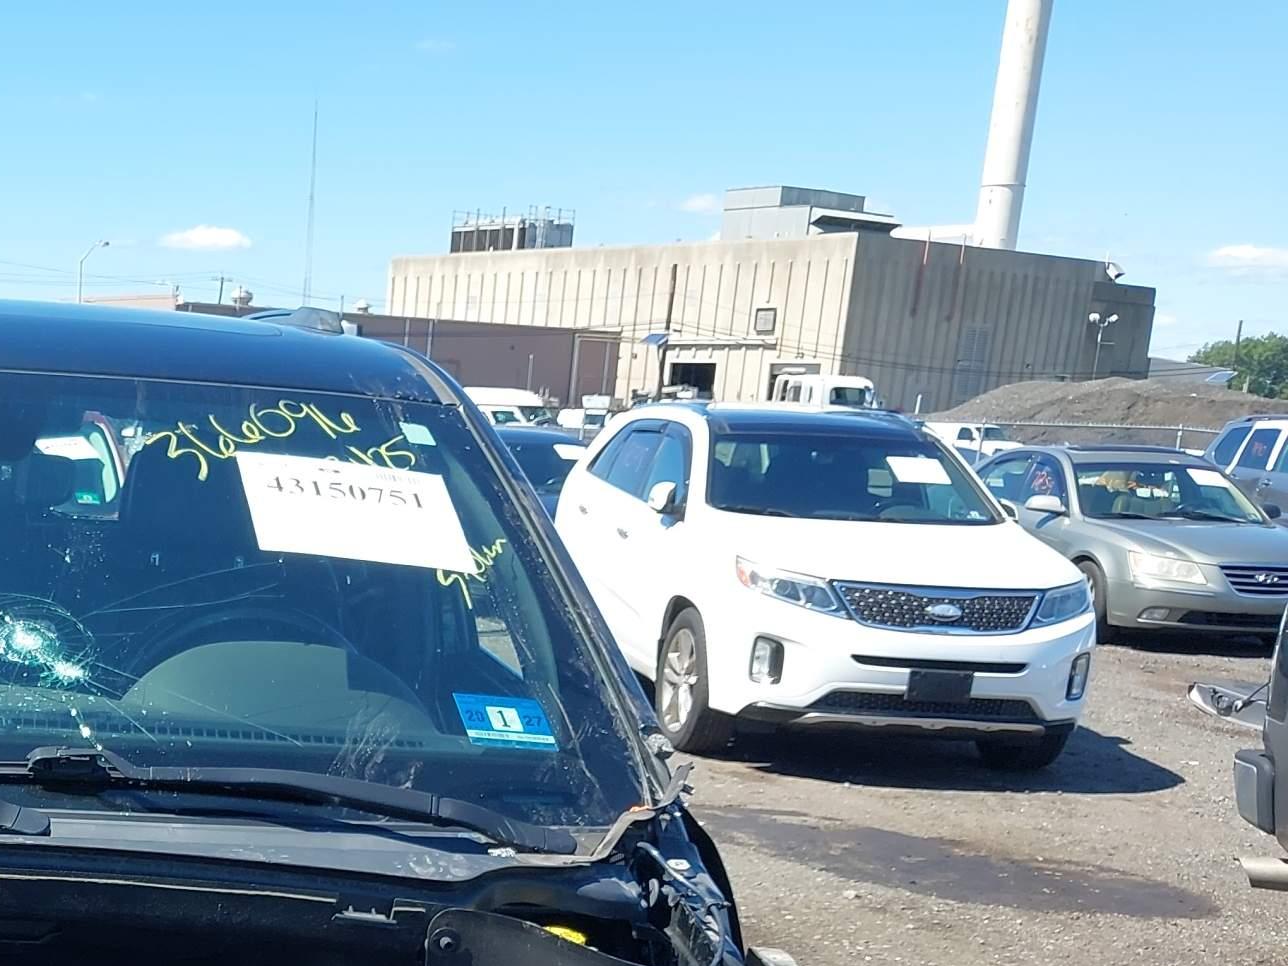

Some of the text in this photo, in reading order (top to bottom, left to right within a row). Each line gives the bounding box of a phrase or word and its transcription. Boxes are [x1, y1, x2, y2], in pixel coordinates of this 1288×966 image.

[266, 475, 424, 509] 43150751
[496, 710, 511, 729] 1
[523, 715, 543, 728] 27
